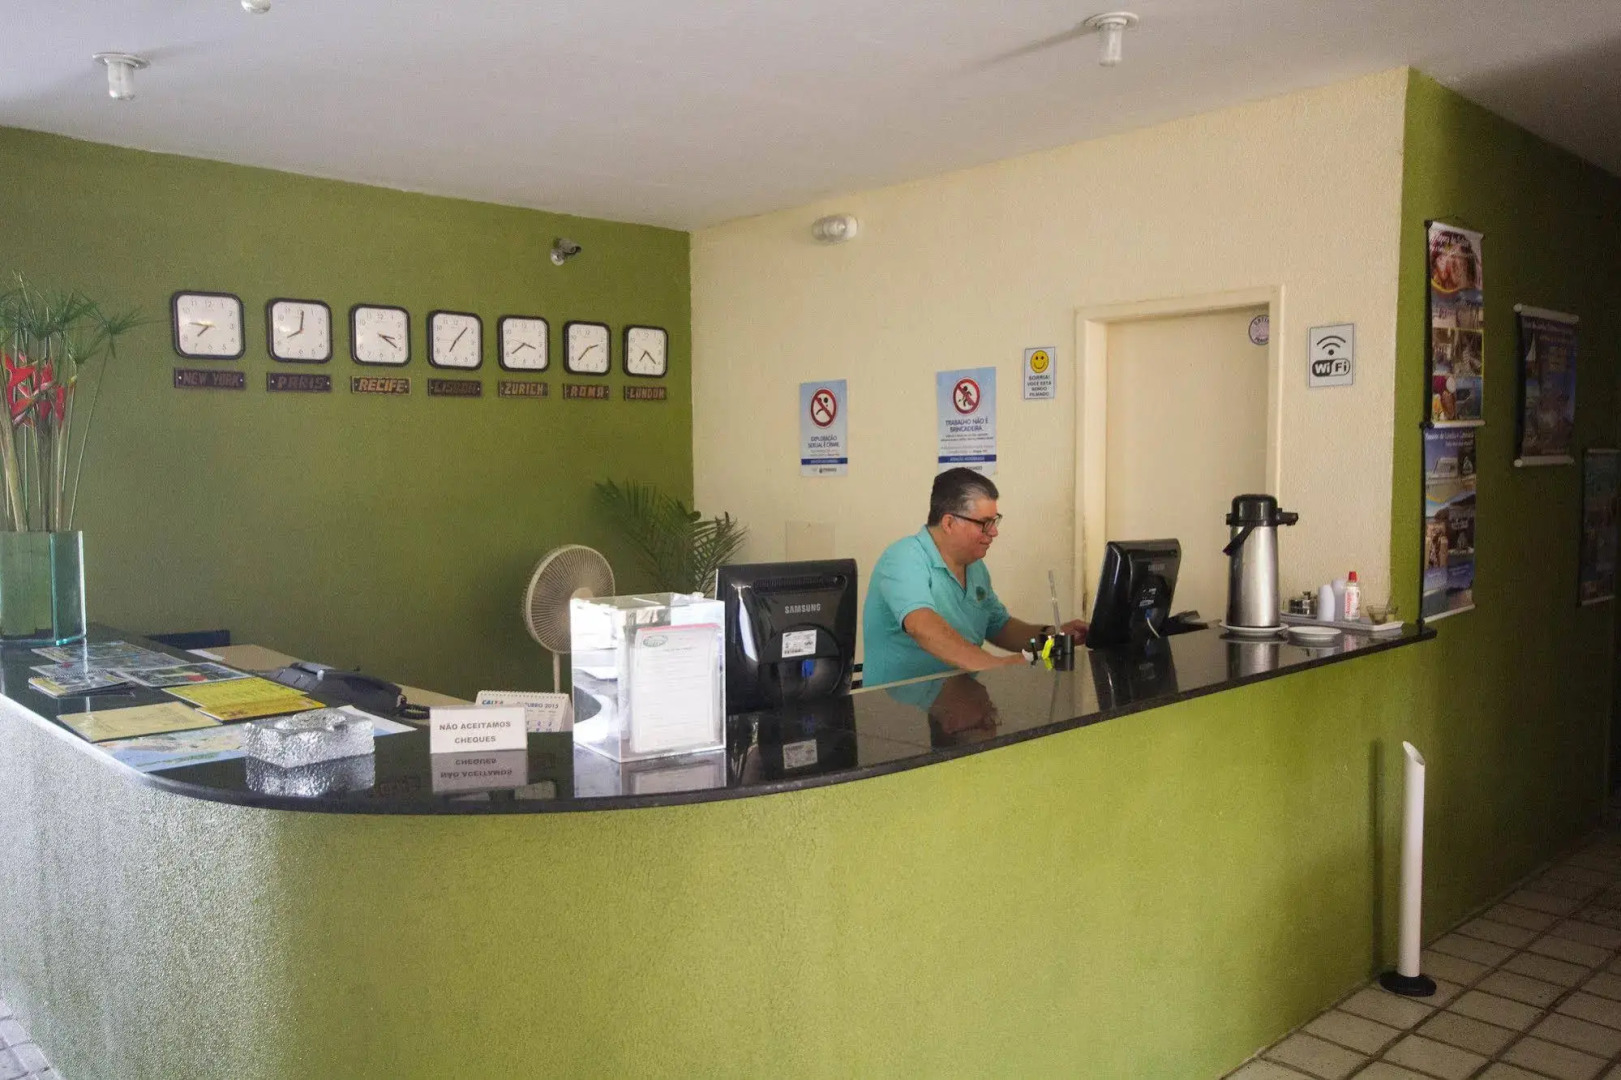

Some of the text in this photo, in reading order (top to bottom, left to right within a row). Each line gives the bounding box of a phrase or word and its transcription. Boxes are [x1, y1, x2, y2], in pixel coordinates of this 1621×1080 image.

[184, 373, 239, 386] NEW YORK
[278, 376, 326, 388] PARIS
[358, 378, 406, 392] RECIFE
[504, 382, 543, 395] ZURICH
[570, 386, 604, 397] ROMA
[630, 388, 664, 399] LONDON
[810, 434, 837, 442] EXPLORAÇÃO
[784, 603, 821, 614] SAMSUNG
[439, 721, 511, 730] NÃO ACEITAMOS
[454, 736, 496, 744] CHEQUES
